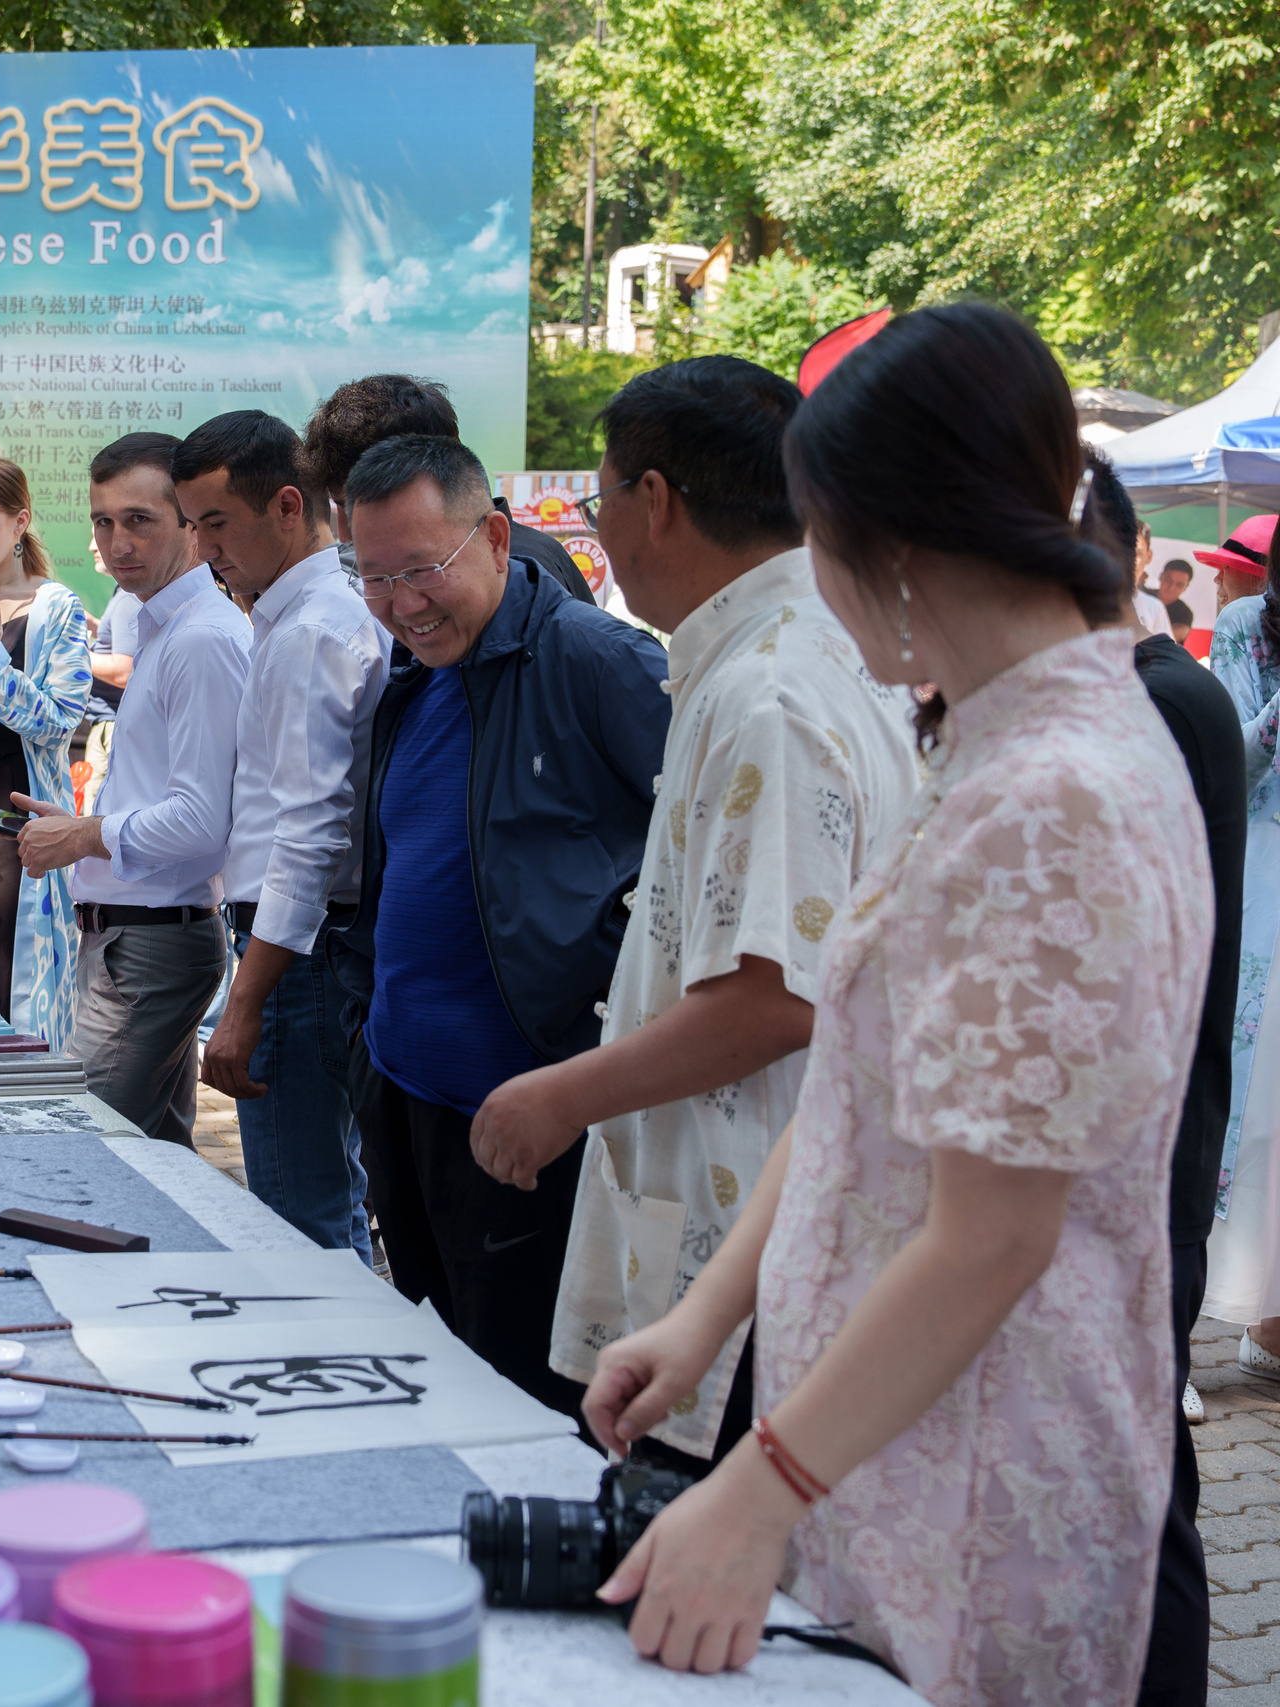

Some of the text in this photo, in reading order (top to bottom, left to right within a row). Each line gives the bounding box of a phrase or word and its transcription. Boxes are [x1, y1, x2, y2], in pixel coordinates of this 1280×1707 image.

[89, 218, 227, 264] Food
[36, 321, 93, 337] Republic
[96, 321, 111, 335] of
[113, 321, 153, 335] China
[157, 321, 169, 335] in
[172, 321, 247, 335] Uzbekistan
[30, 377, 87, 392] National
[92, 377, 147, 392] Cultural
[151, 377, 197, 392] Centre
[201, 377, 214, 392] in
[219, 377, 282, 392] Tashkent
[36, 424, 74, 438] Trans
[33, 510, 84, 523] Noodle
[50, 554, 84, 567] ouse
